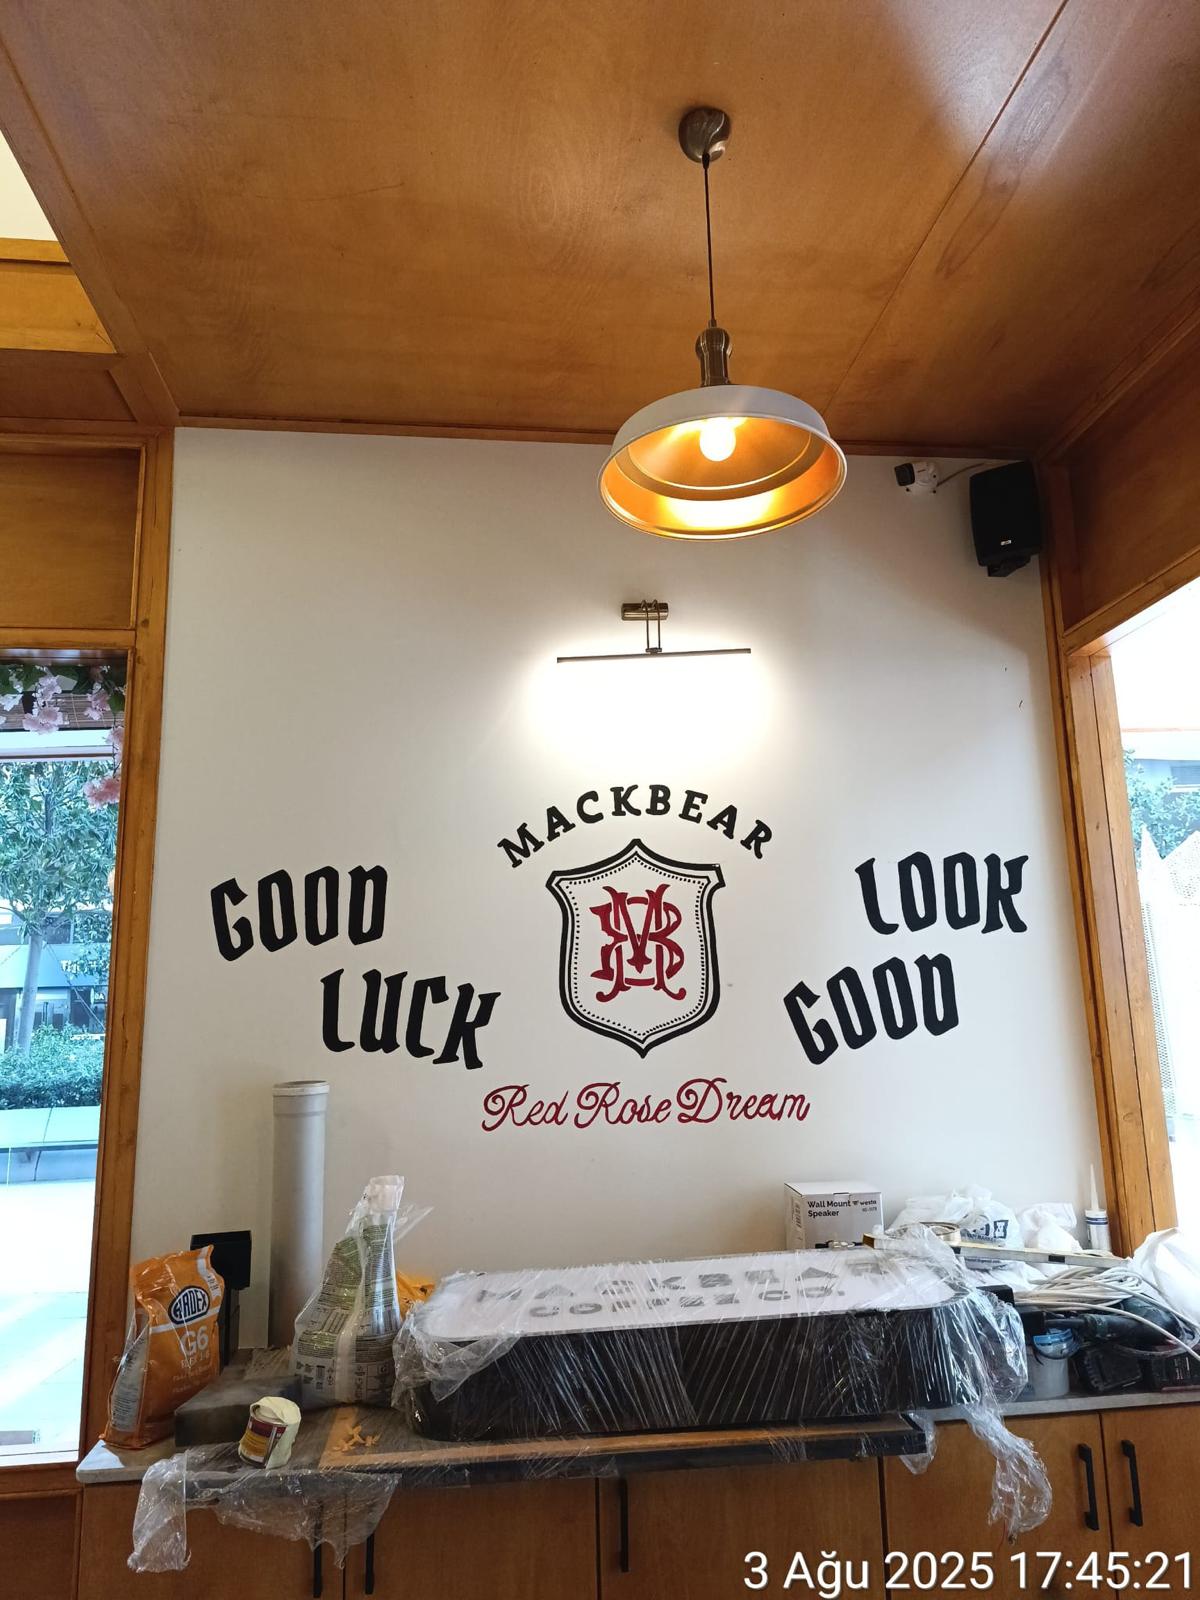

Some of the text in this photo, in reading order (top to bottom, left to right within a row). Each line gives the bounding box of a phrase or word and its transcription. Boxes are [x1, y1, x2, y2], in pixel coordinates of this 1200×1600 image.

[497, 784, 773, 868] MACKBEAR
[210, 865, 388, 961] GOOD
[855, 851, 1029, 935] LOOK
[320, 968, 501, 1070] LUCK
[783, 953, 959, 1065] GOOD
[480, 1077, 810, 1132] Red Rose Dream
[807, 1200, 851, 1208] Wall Mount
[807, 1210, 840, 1219] Speaker
